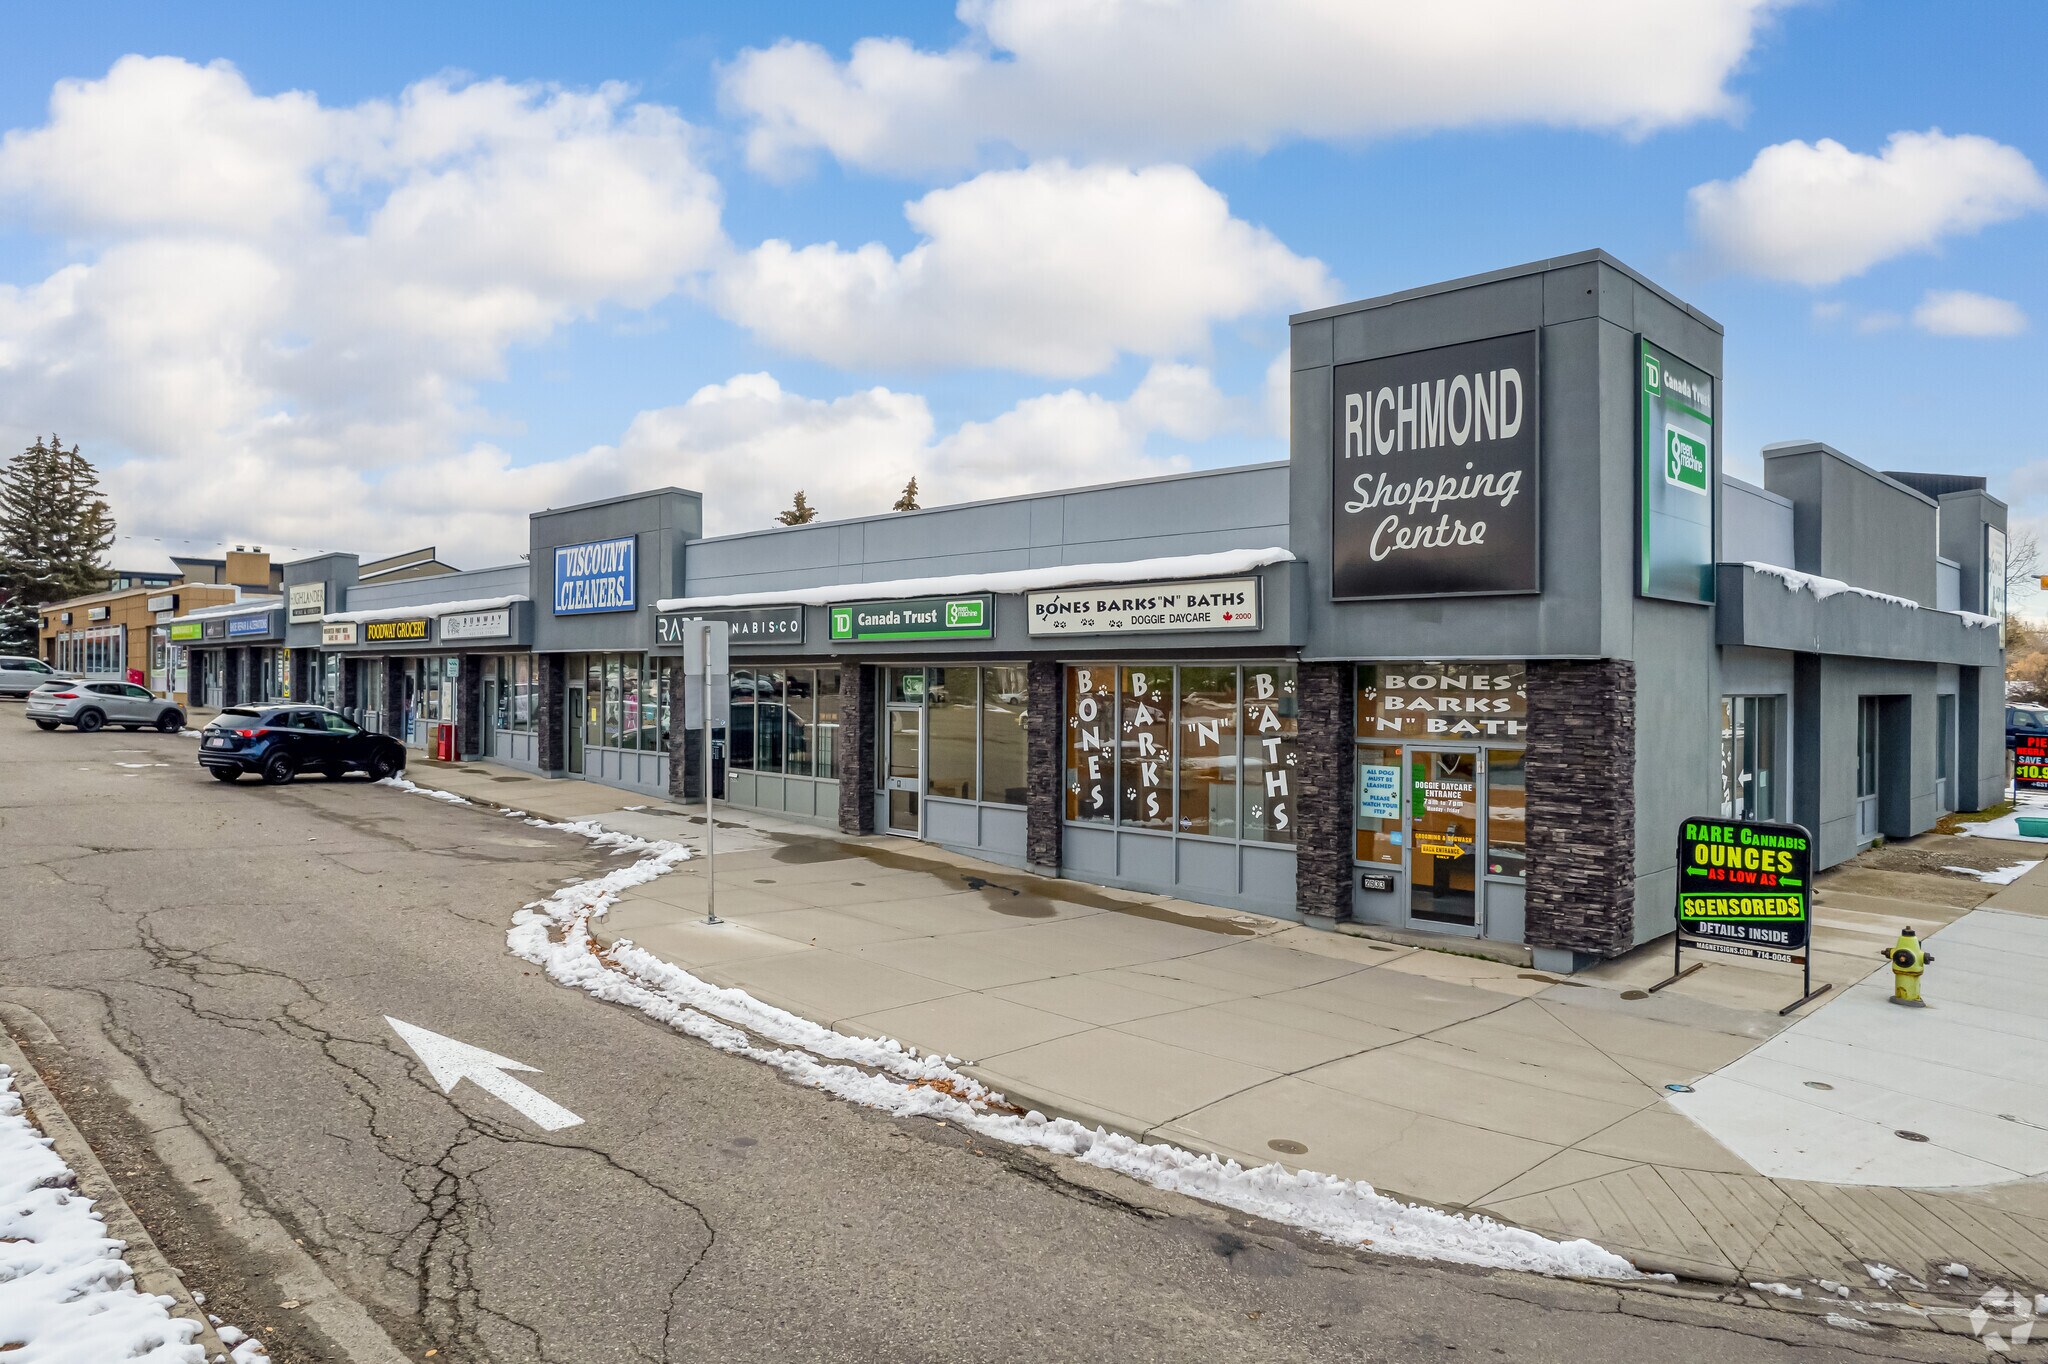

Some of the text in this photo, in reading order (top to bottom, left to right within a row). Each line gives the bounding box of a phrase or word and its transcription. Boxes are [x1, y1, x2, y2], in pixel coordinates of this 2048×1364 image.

[1664, 369, 1711, 409] Canada Trust
[1345, 367, 1523, 459] RICHMOND
[1680, 452, 1703, 474] machine
[1344, 461, 1523, 515] Shopping
[1369, 514, 1487, 562] Centre
[565, 540, 628, 577] VISCOUNT
[561, 575, 625, 611] CLEANERS
[1036, 600, 1090, 616] BONES
[1096, 597, 1156, 613] BARKS
[1187, 592, 1245, 608] BATHS
[834, 613, 850, 633] TD
[857, 609, 938, 626] Canada Trust
[1131, 612, 1211, 626] DOGGIE DAYCARE
[1235, 612, 1252, 620] 2000
[368, 623, 397, 640] FOODWAY
[397, 621, 426, 638] GROCERY
[1385, 674, 1512, 691] BONES
[1384, 696, 1511, 713] BARKS
[1077, 670, 1104, 810] BONES
[1131, 672, 1160, 818] BARKS
[1255, 673, 1289, 831] BATHS
[2018, 755, 2042, 765] SAVE
[1415, 781, 1473, 792] DOGGIE DAYCARE
[1425, 790, 1462, 799] ENTRANCE
[1423, 798, 1439, 806] 7am
[1415, 833, 1441, 841] GROOMING
[1686, 824, 1735, 844] RARE
[1695, 843, 1793, 873] OUNCES
[1708, 868, 1777, 887] AS LOW AS
[1684, 896, 1800, 918] $CENSORED$
[1699, 921, 1789, 943] DETAILS INSIDE
[1696, 942, 1792, 963] MAGNETSIGNS.COM 714-0045
